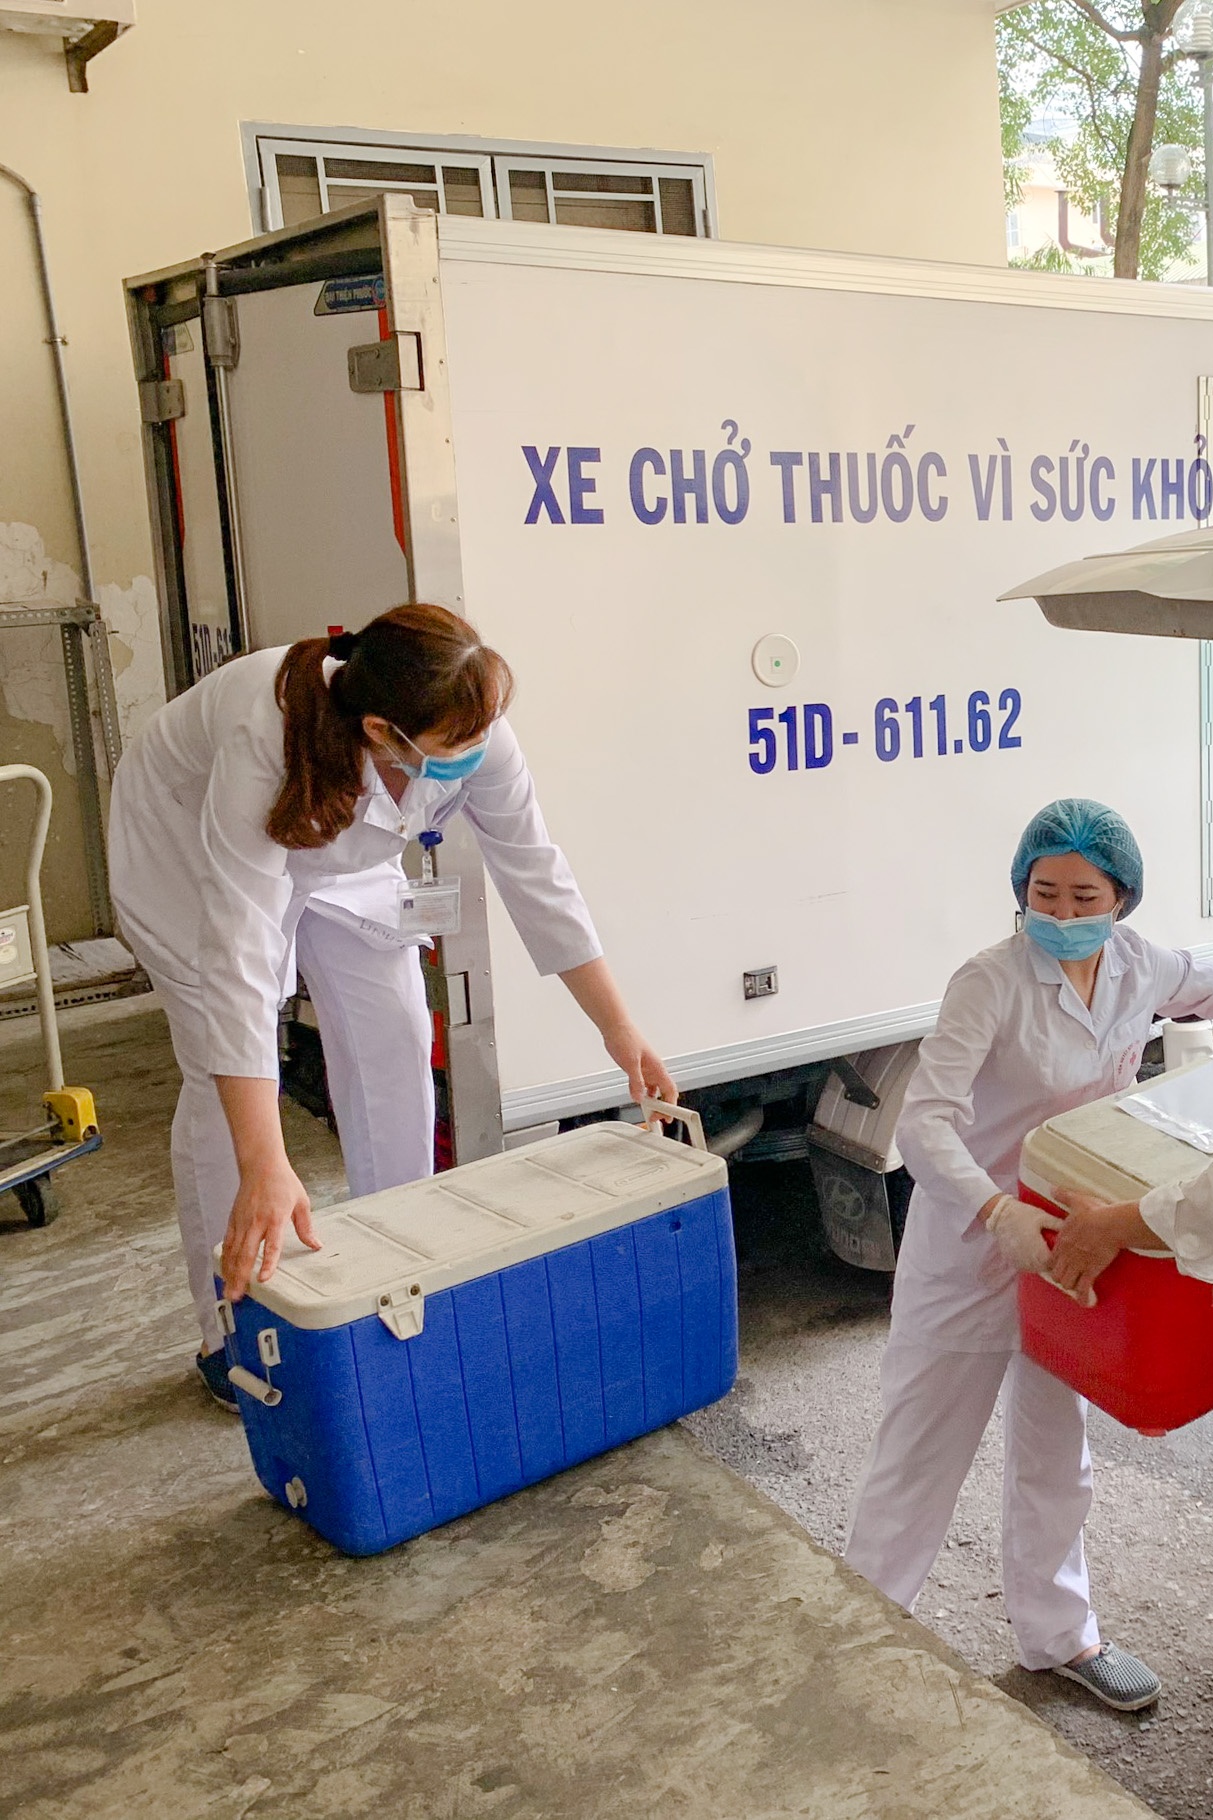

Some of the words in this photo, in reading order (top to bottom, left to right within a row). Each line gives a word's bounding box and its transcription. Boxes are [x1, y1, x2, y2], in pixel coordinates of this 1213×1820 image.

[521, 446, 604, 525] XE
[629, 419, 751, 525] CHỞ
[769, 424, 949, 524] THUỐC
[967, 437, 1013, 521] VÌ
[1029, 439, 1116, 522] SỨC
